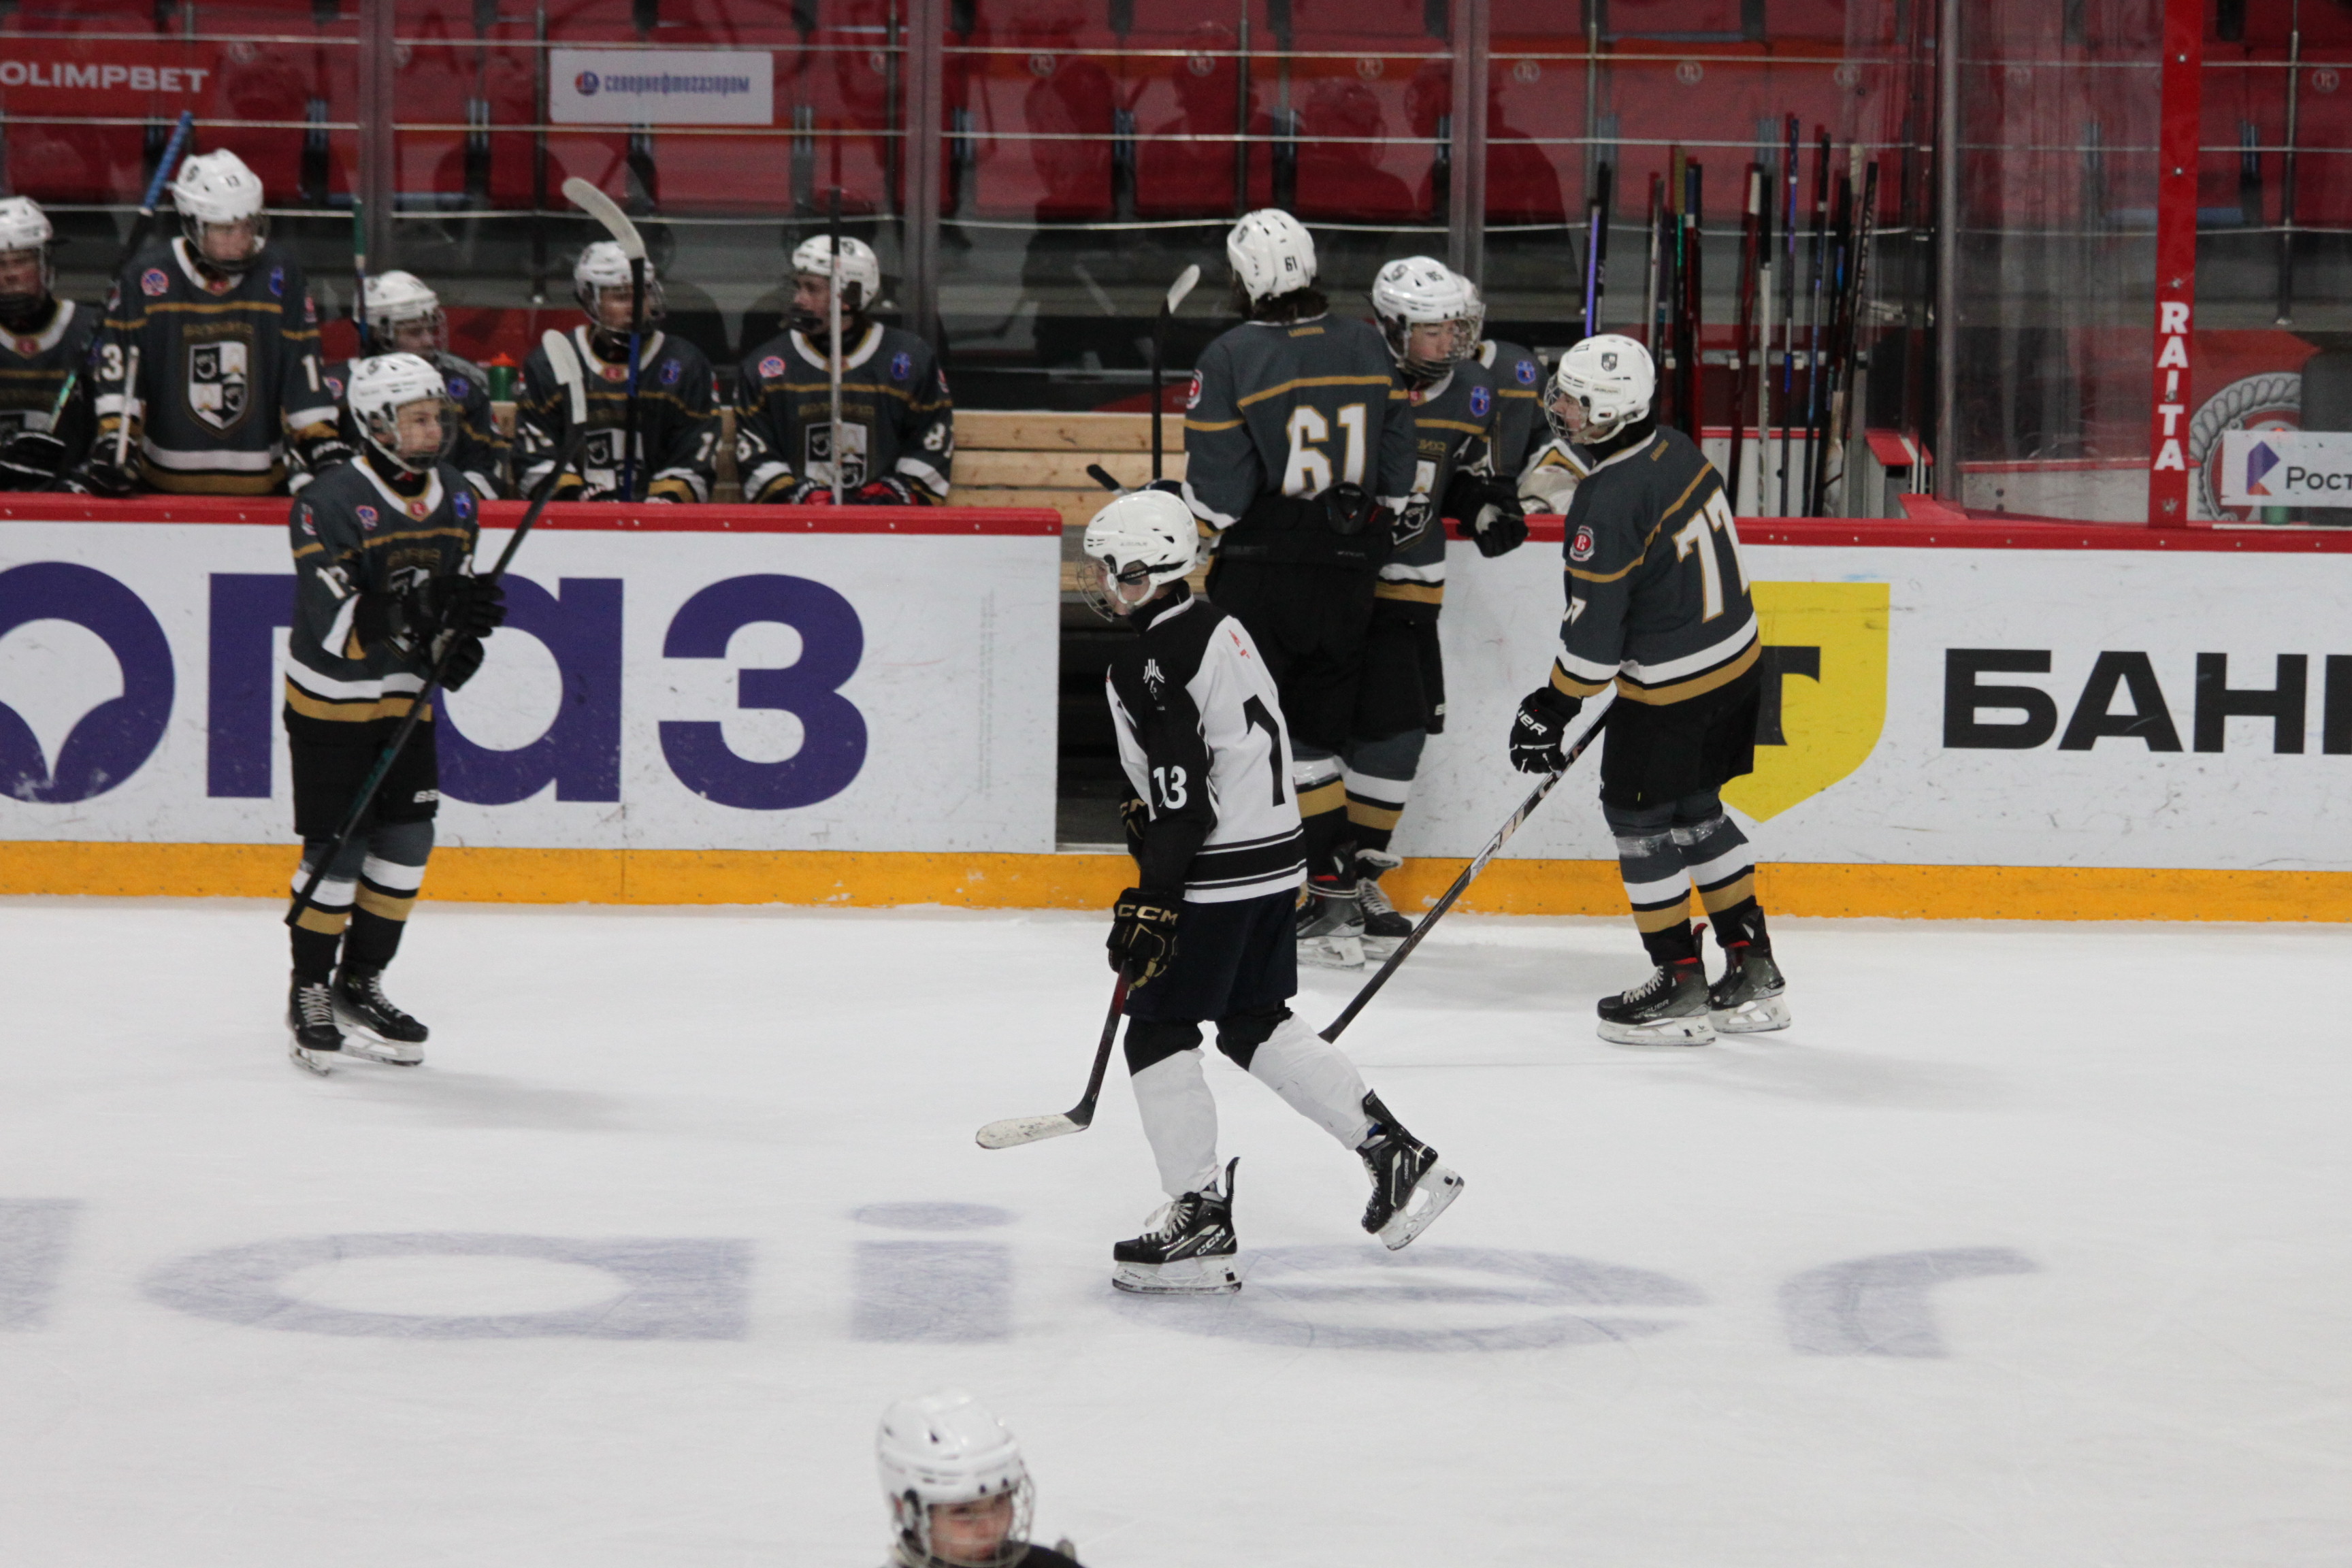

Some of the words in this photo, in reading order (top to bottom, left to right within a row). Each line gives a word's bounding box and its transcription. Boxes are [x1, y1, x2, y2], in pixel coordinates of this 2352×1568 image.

[0, 61, 210, 93] OLIMPBET
[1285, 255, 1298, 272] 61
[2146, 301, 2190, 471] RAITA
[1283, 403, 1367, 501] 61
[1674, 485, 1750, 623] 77
[1152, 765, 1188, 810] 13
[1117, 904, 1179, 926] CCM
[1196, 1227, 1227, 1257] CCM
